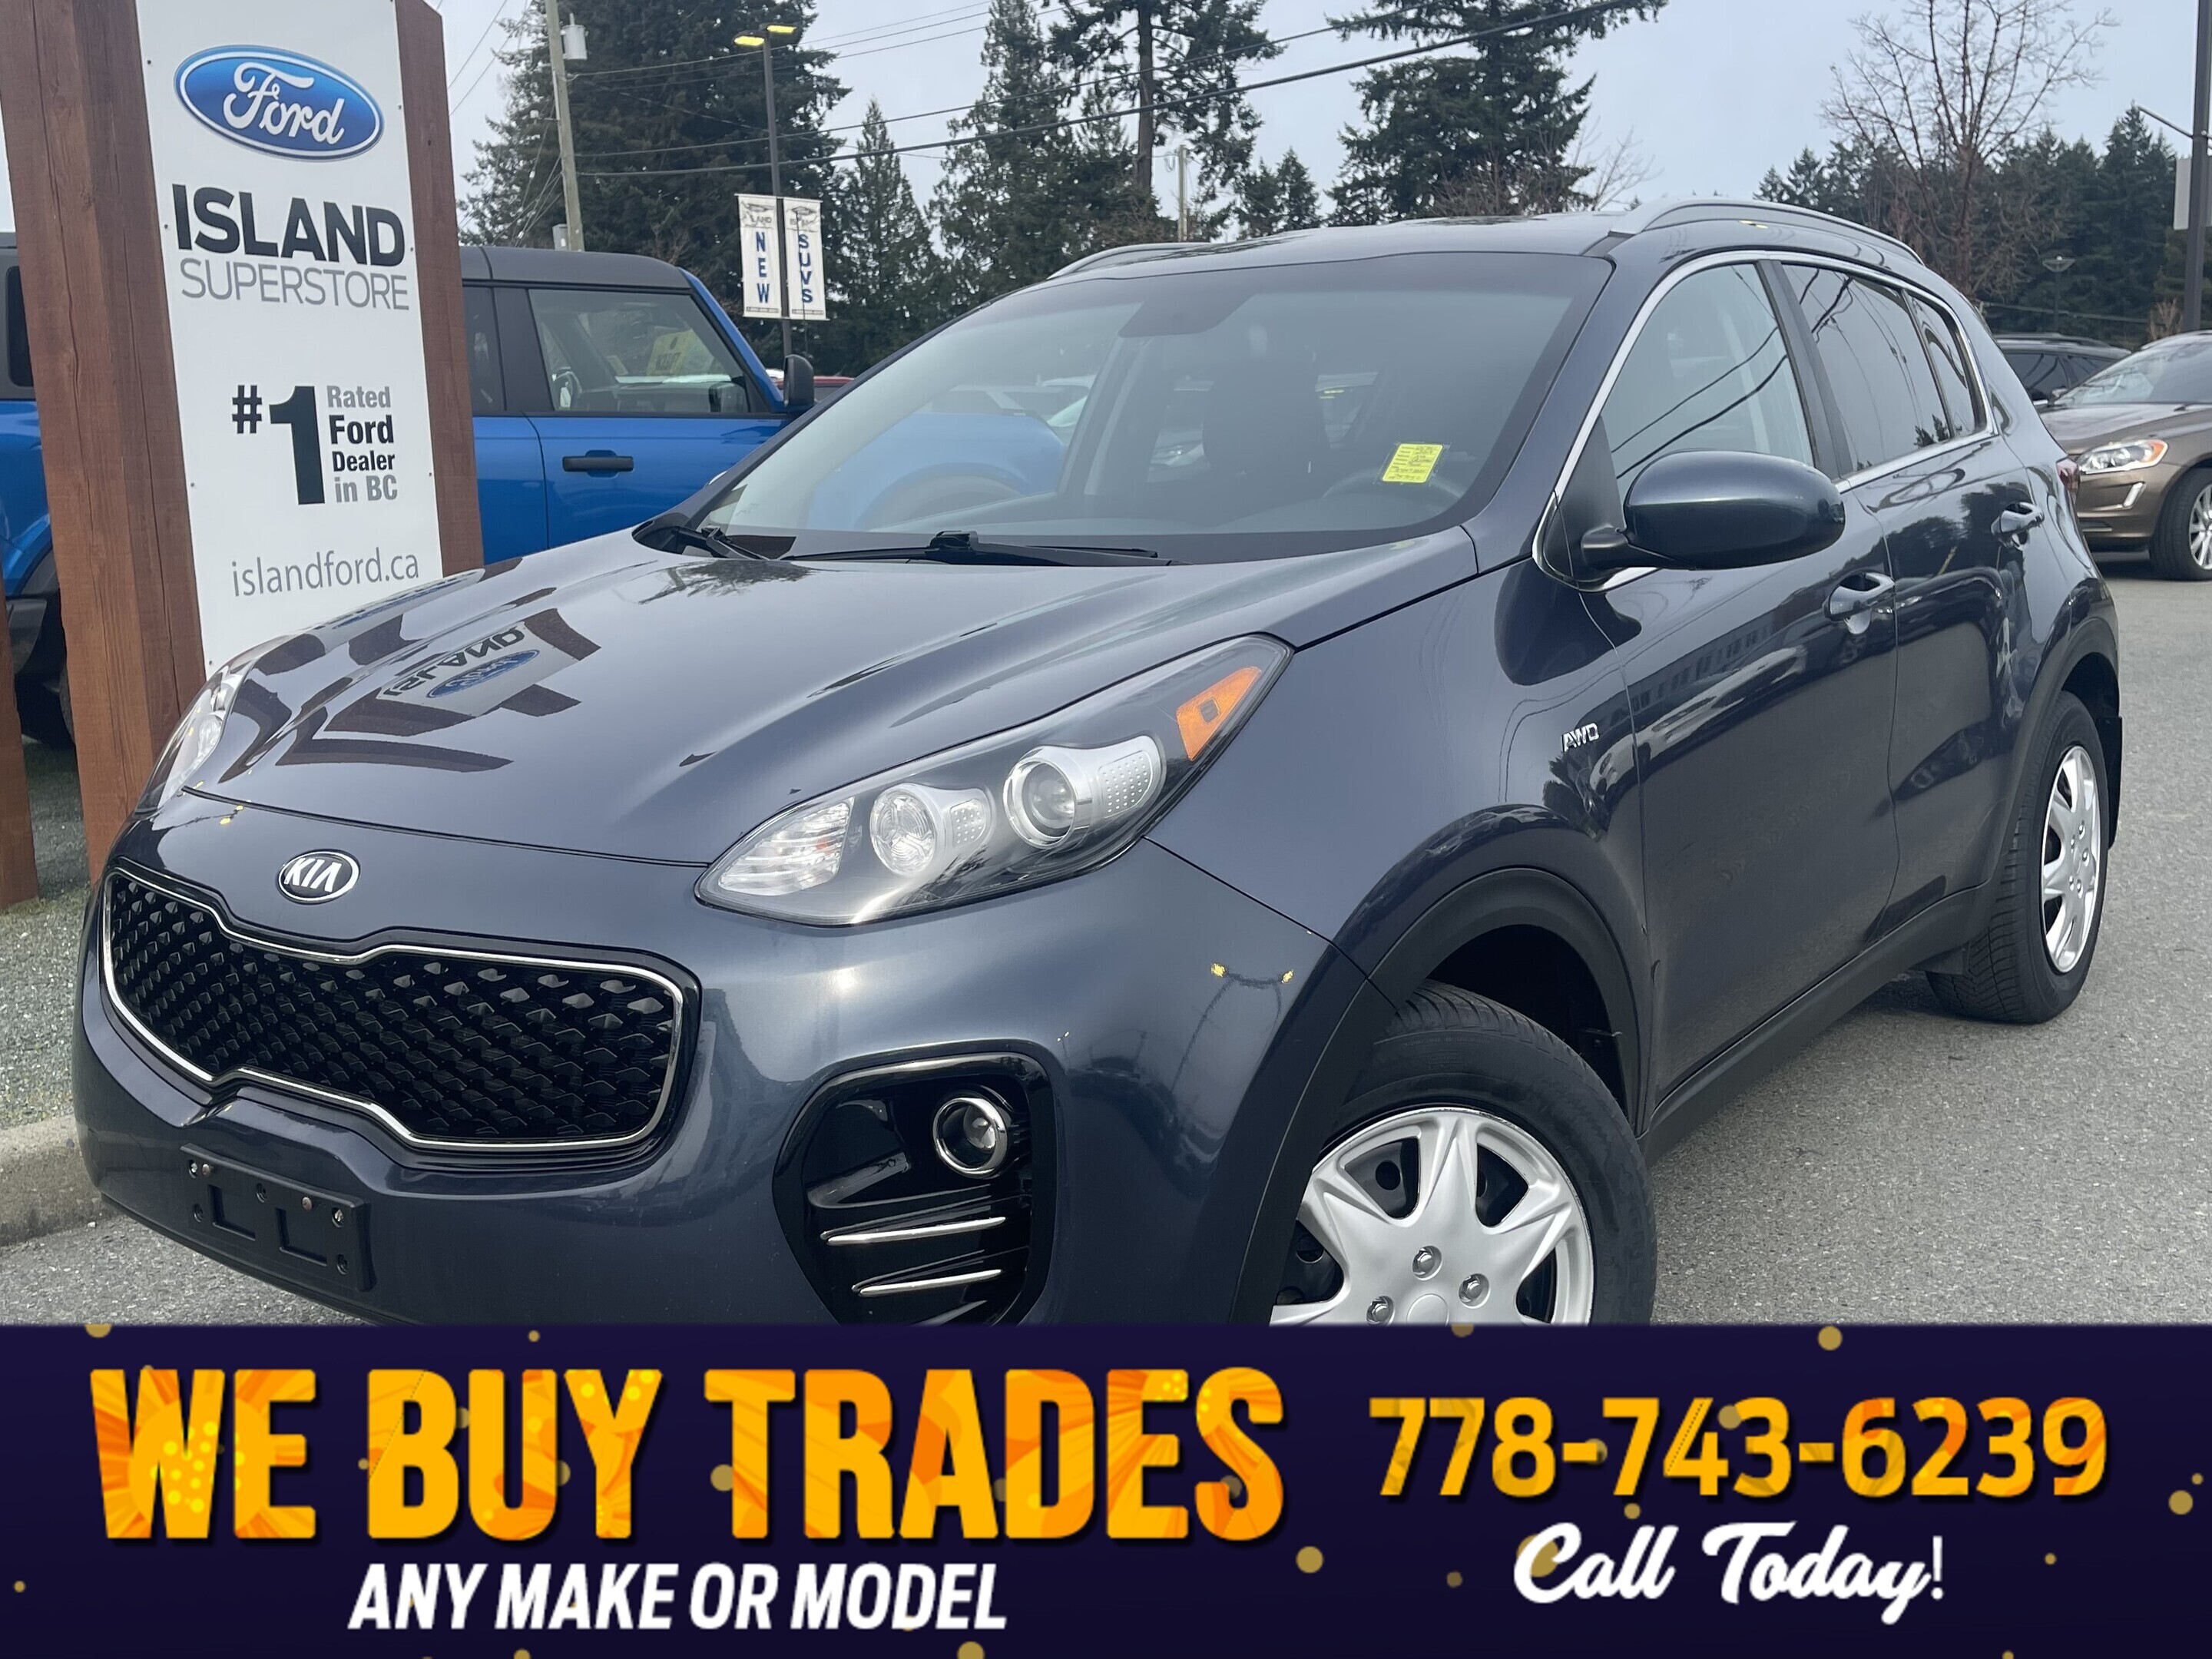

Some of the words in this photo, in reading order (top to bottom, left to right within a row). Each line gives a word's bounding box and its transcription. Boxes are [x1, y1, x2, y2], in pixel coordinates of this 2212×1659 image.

[223, 61, 345, 145] Ford
[171, 183, 406, 267] ISLAND
[180, 257, 409, 311] SUPERSTORE
[755, 231, 770, 303] NEW
[326, 385, 392, 408] Rated
[231, 384, 326, 505] #1
[329, 414, 395, 445] Ford
[332, 450, 396, 472] Dealer
[335, 476, 358, 503] in
[366, 474, 398, 502] BC
[232, 546, 419, 598] islandford.ca
[1561, 722, 1600, 752] AWD
[283, 857, 343, 892] KIA
